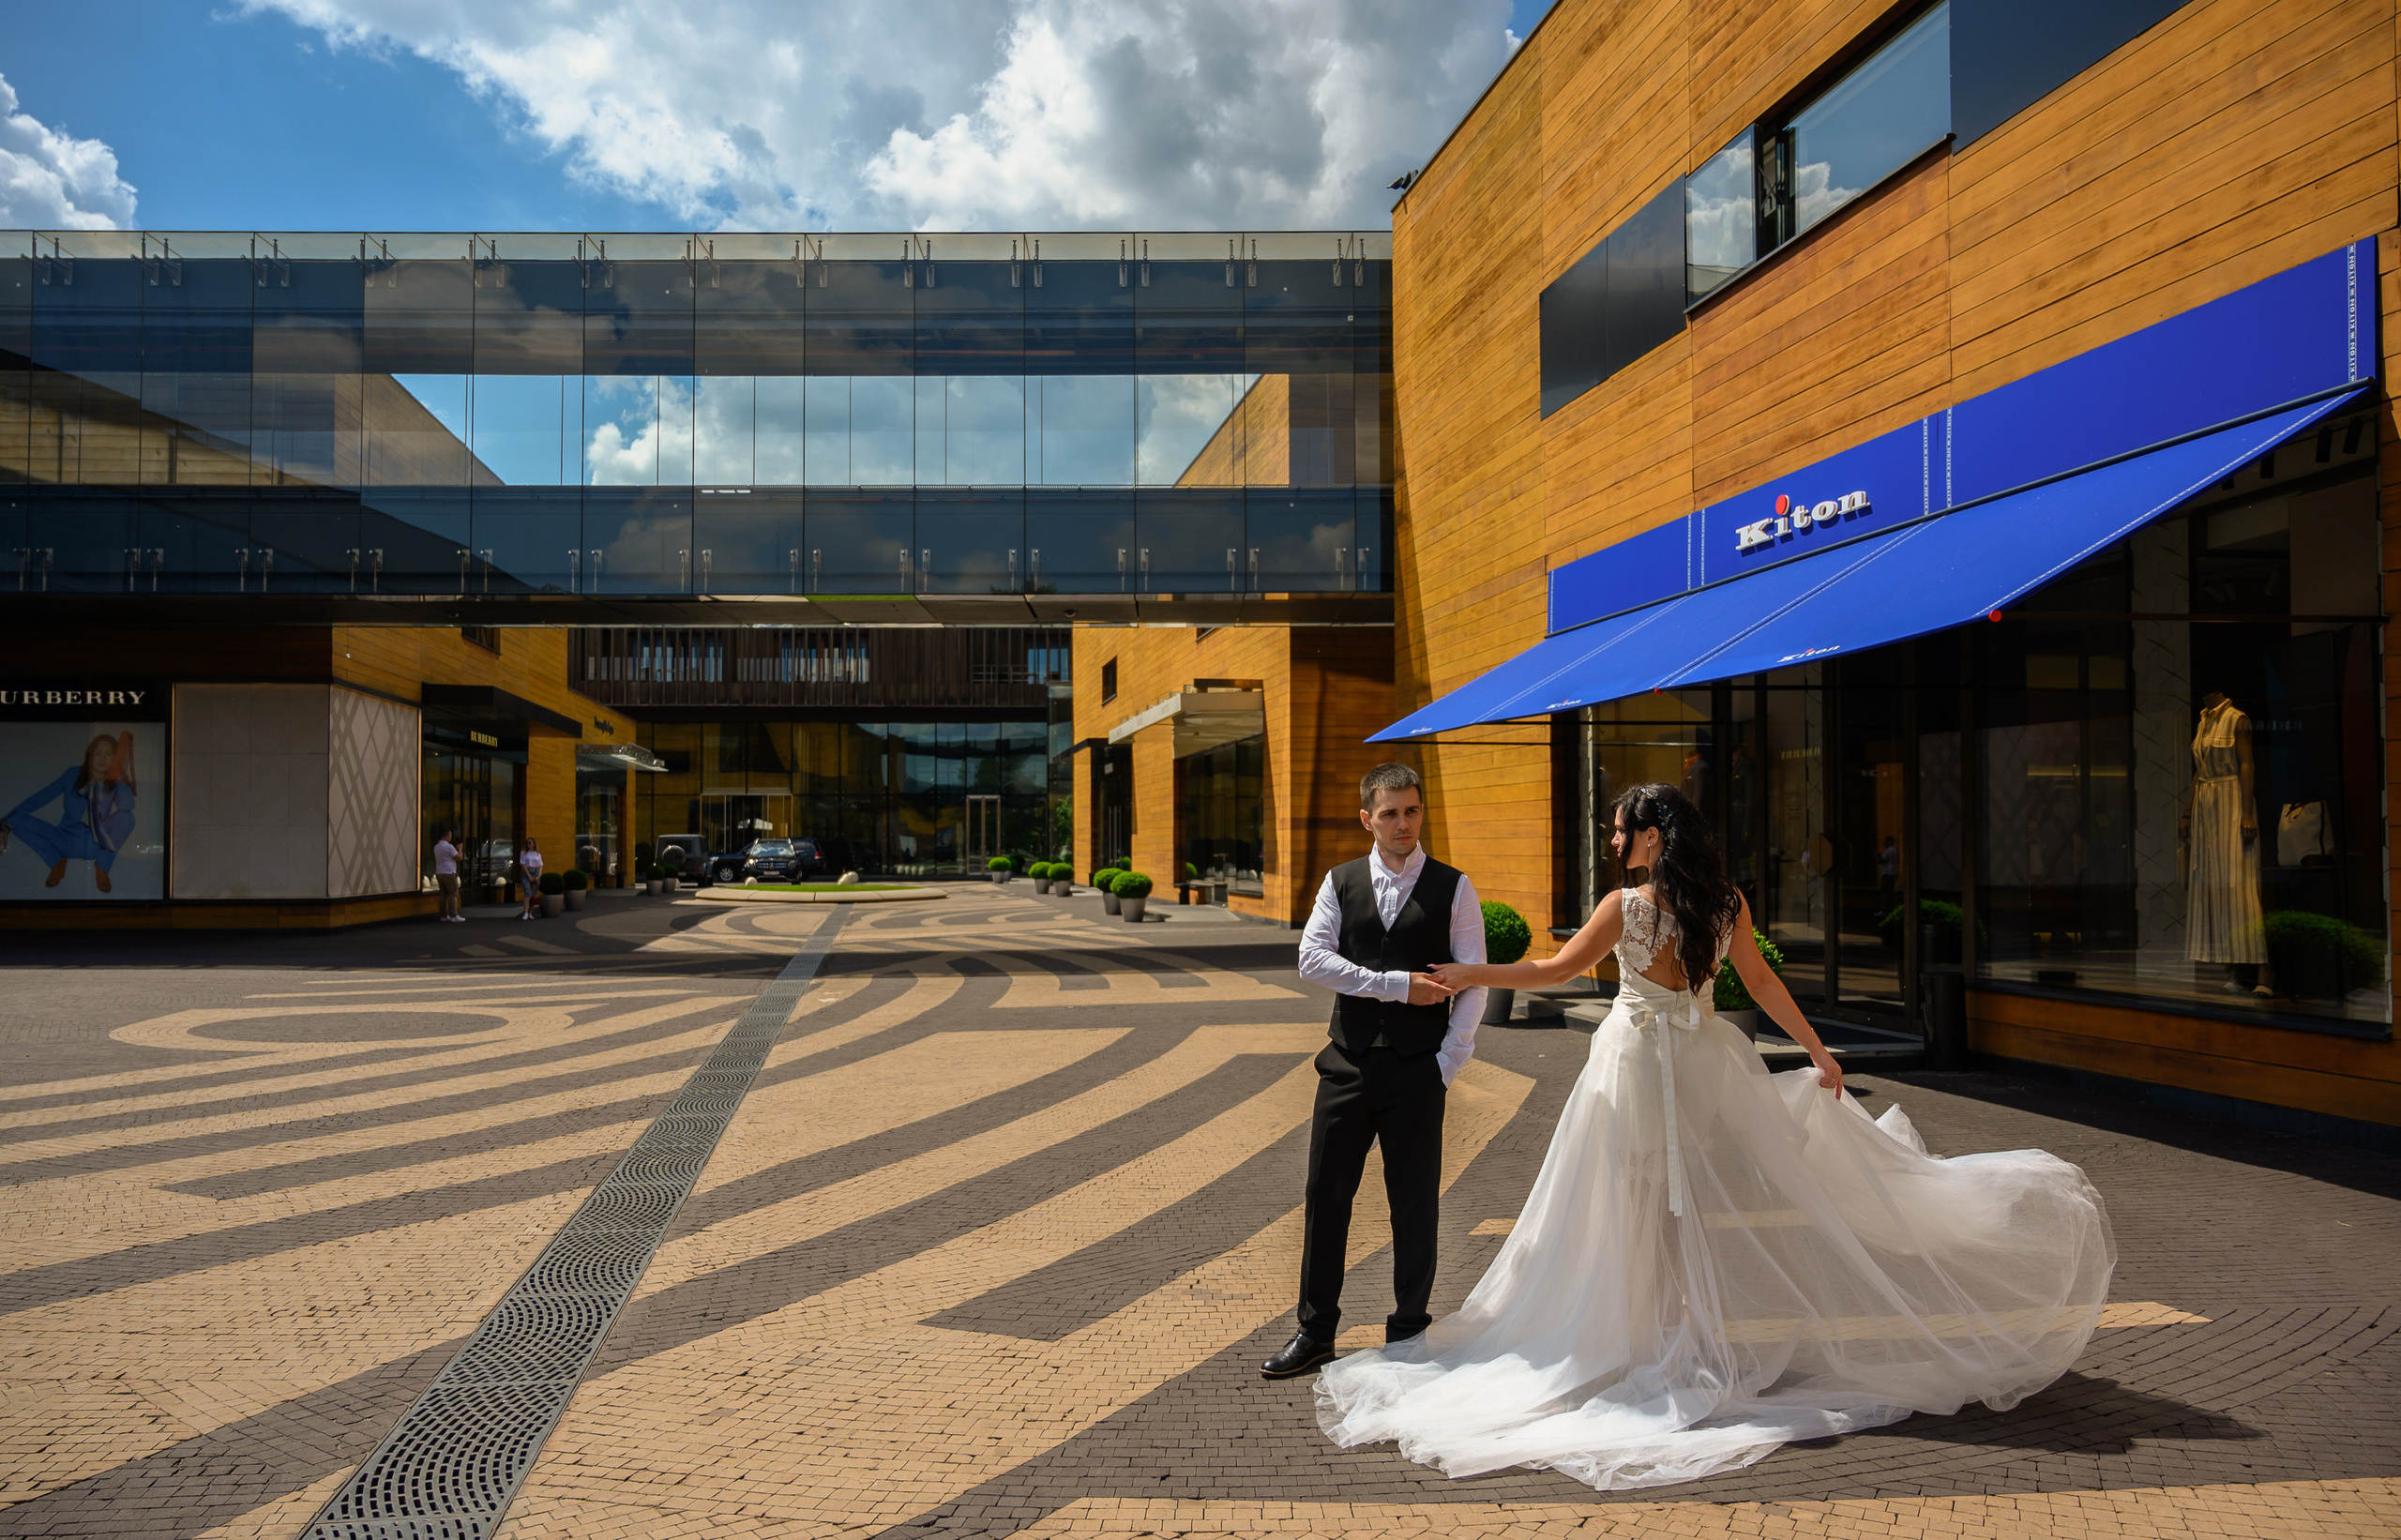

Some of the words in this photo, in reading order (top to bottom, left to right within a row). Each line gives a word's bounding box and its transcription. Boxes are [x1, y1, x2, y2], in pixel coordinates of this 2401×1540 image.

[1735, 490, 1870, 551] Kiton
[1776, 644, 1840, 663] Kiton
[0, 690, 147, 705] URBERRY
[471, 731, 498, 747] BURBERRY
